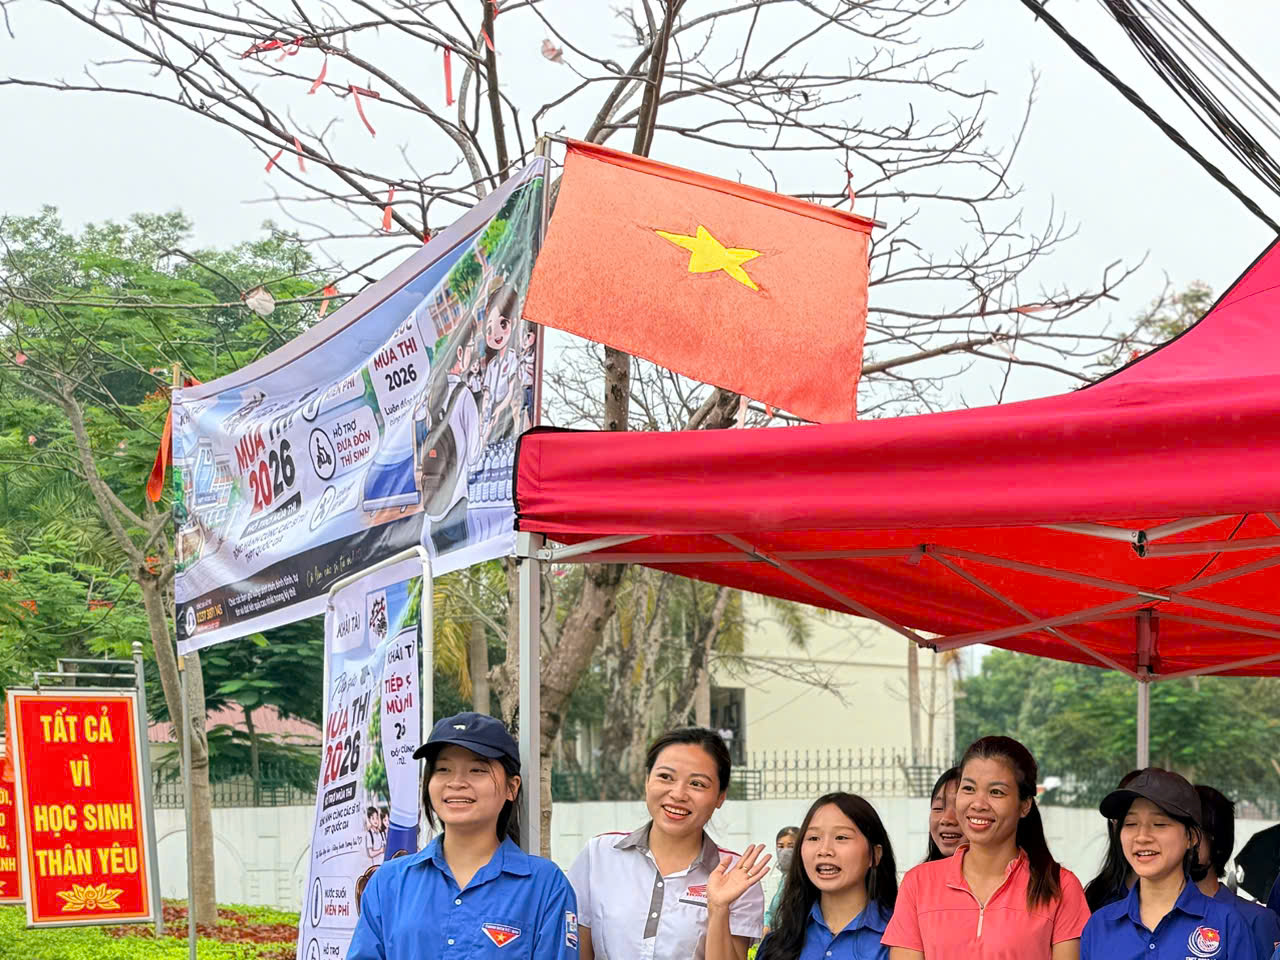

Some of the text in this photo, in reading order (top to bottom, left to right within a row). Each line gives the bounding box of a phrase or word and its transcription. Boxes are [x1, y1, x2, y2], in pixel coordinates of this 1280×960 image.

[374, 337, 418, 371] MÙA THI
[385, 363, 417, 391] 2026
[333, 419, 357, 438] HỖ TRỢ
[336, 428, 371, 453] ĐƯA ĐÓN
[249, 438, 296, 516] 2026
[384, 672, 404, 693] TIẾP
[40, 705, 113, 743] TẤT CẢ
[69, 754, 91, 787] VÌ
[323, 730, 361, 786] 2026
[34, 803, 134, 837] HỌC SINH
[36, 842, 138, 876] THÂN YÊU
[338, 902, 349, 916] PHÍ
[330, 946, 340, 956] TRỢ
